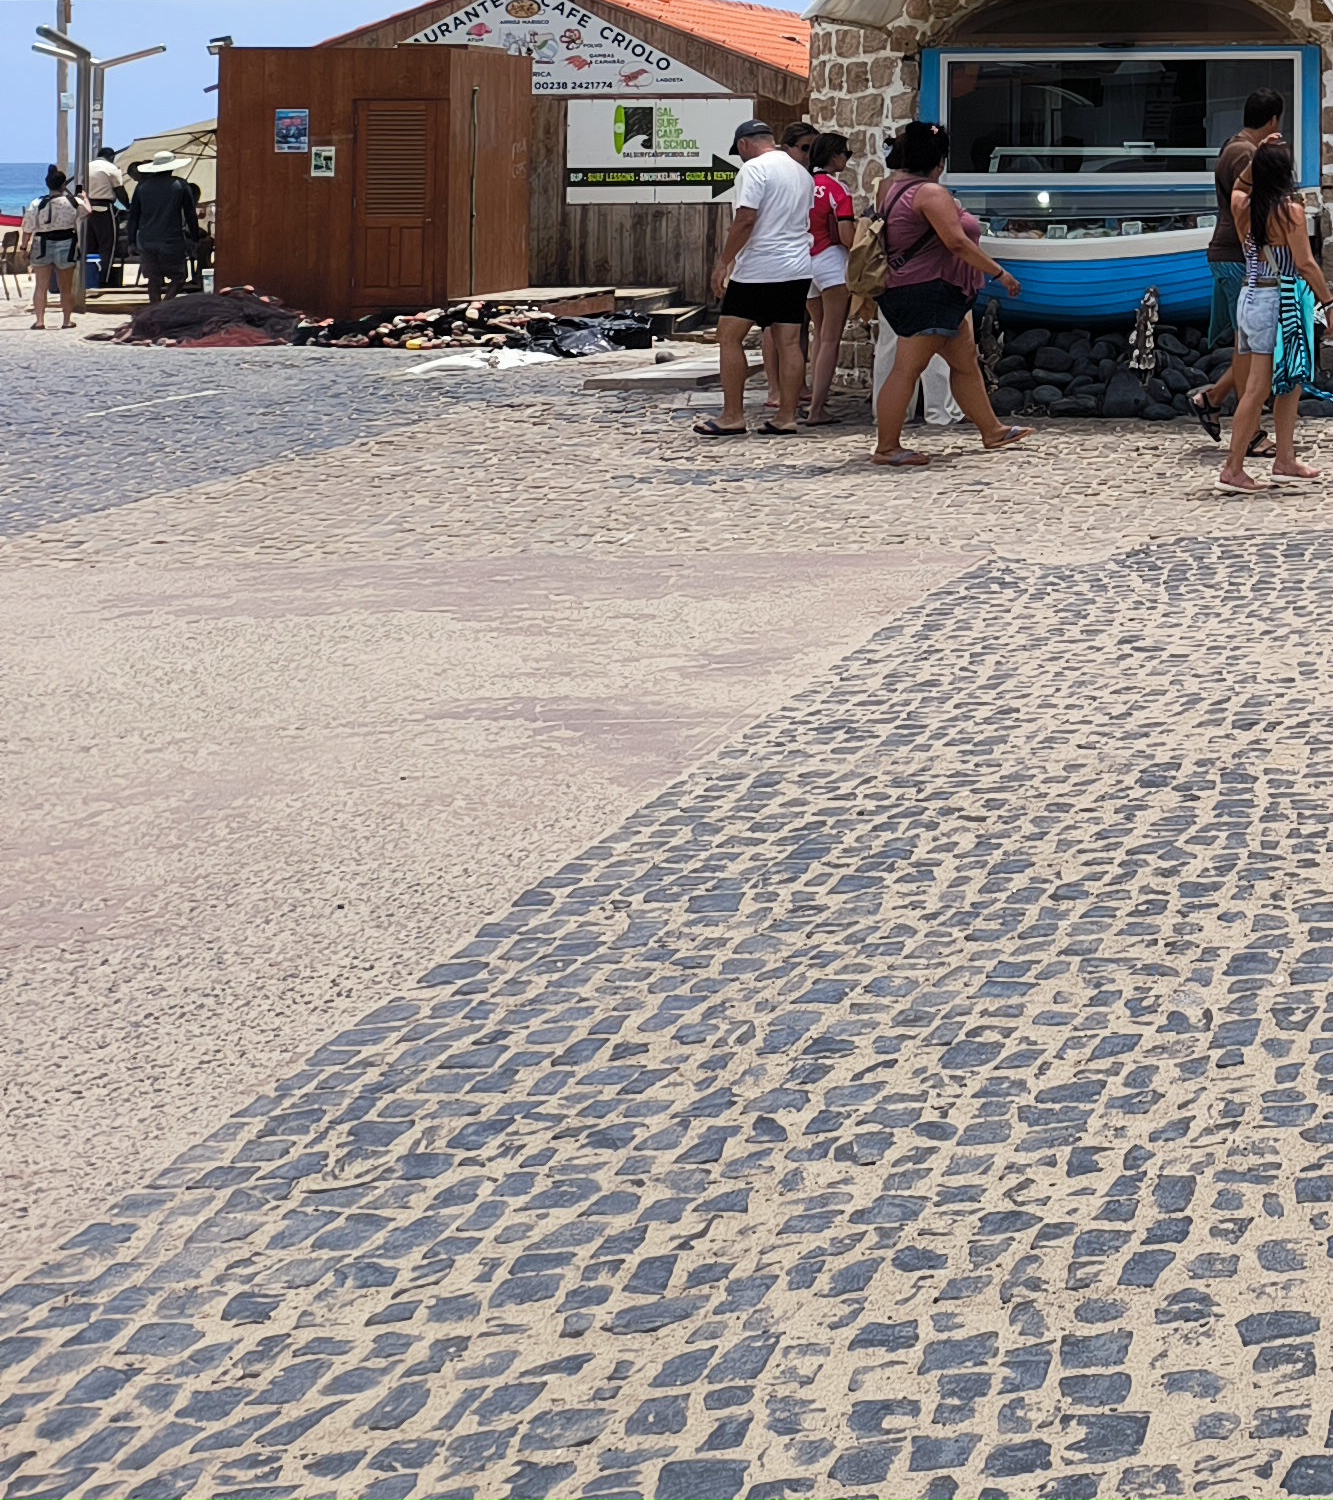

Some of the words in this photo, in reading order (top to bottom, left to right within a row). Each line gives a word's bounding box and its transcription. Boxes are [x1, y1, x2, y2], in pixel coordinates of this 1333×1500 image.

[600, 26, 671, 71] CRIOLO
[534, 82, 567, 90] 00238
[571, 81, 613, 90] 2421774
[657, 107, 674, 117] SAL
[657, 118, 679, 128] SURF
[656, 128, 684, 138] CAMP
[663, 139, 700, 150] SCHOOL
[587, 172, 604, 182] SURF
[605, 172, 635, 182] LESSONS
[685, 171, 705, 181] GUIDE
